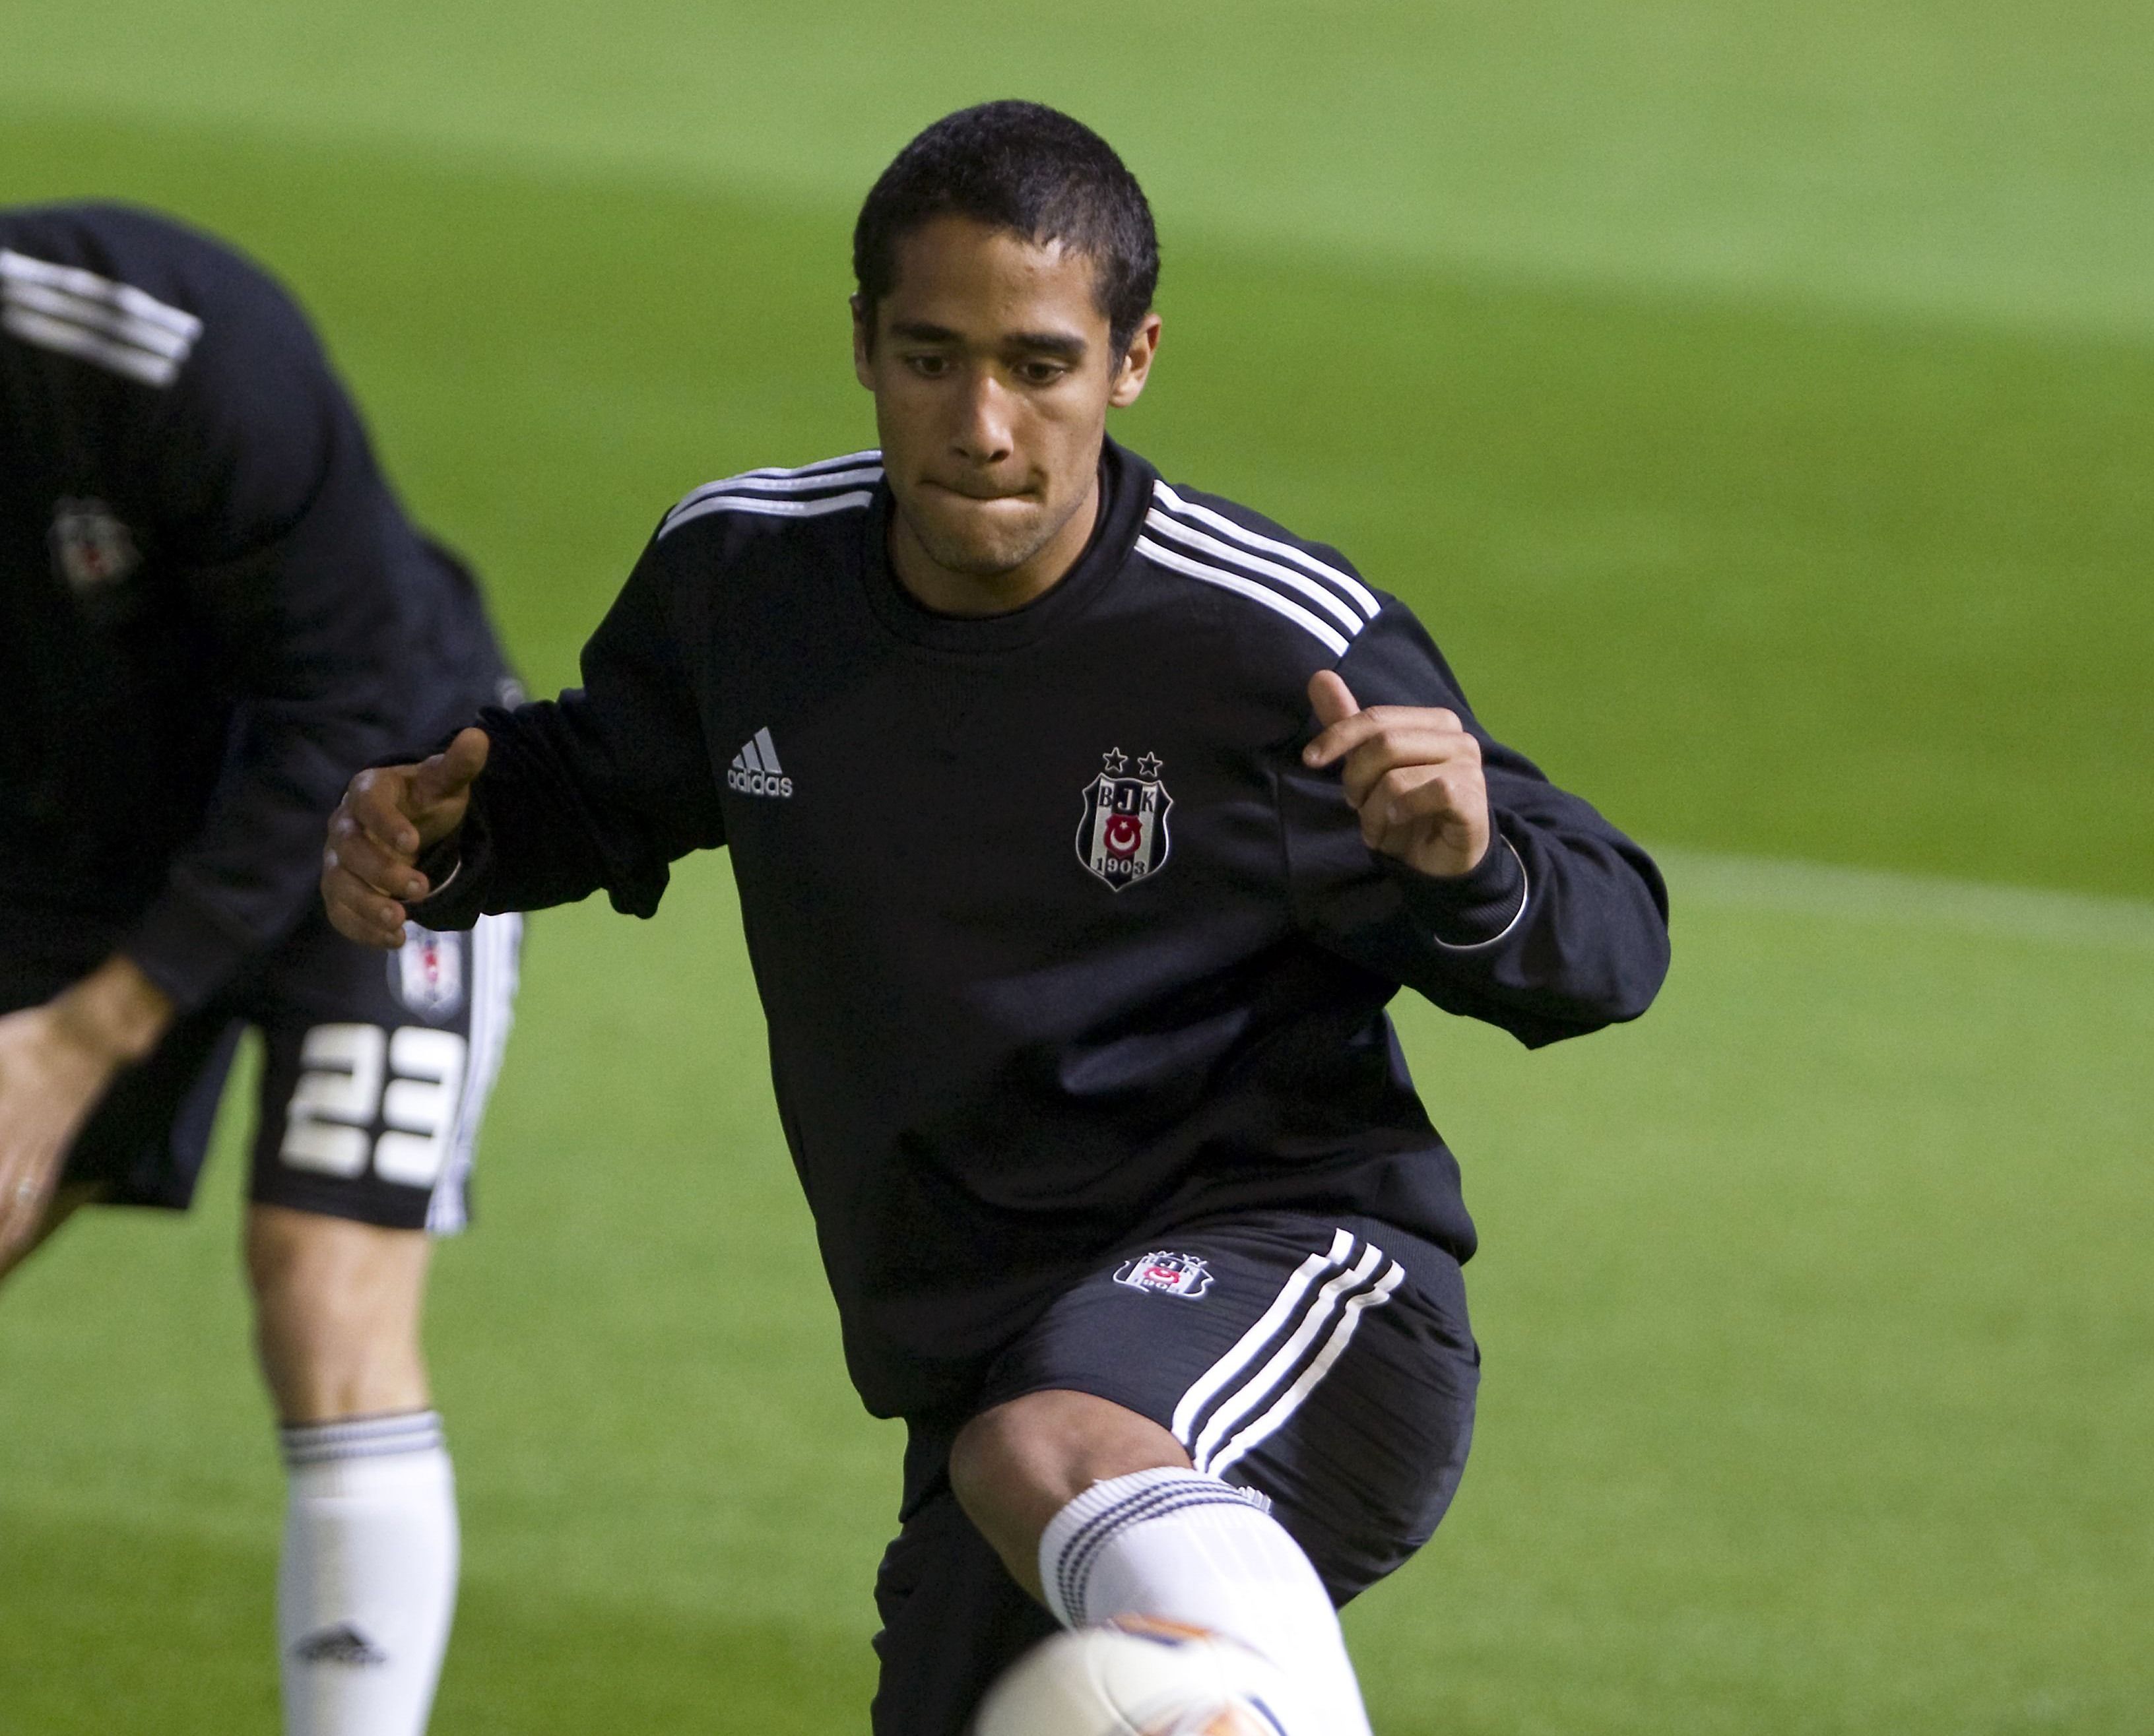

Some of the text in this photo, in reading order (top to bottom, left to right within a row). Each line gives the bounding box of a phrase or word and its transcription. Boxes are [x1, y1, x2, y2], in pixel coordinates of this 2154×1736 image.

[727, 767, 793, 798] adidas
[1095, 857, 1146, 875] 1903
[277, 1021, 468, 1188] 23
